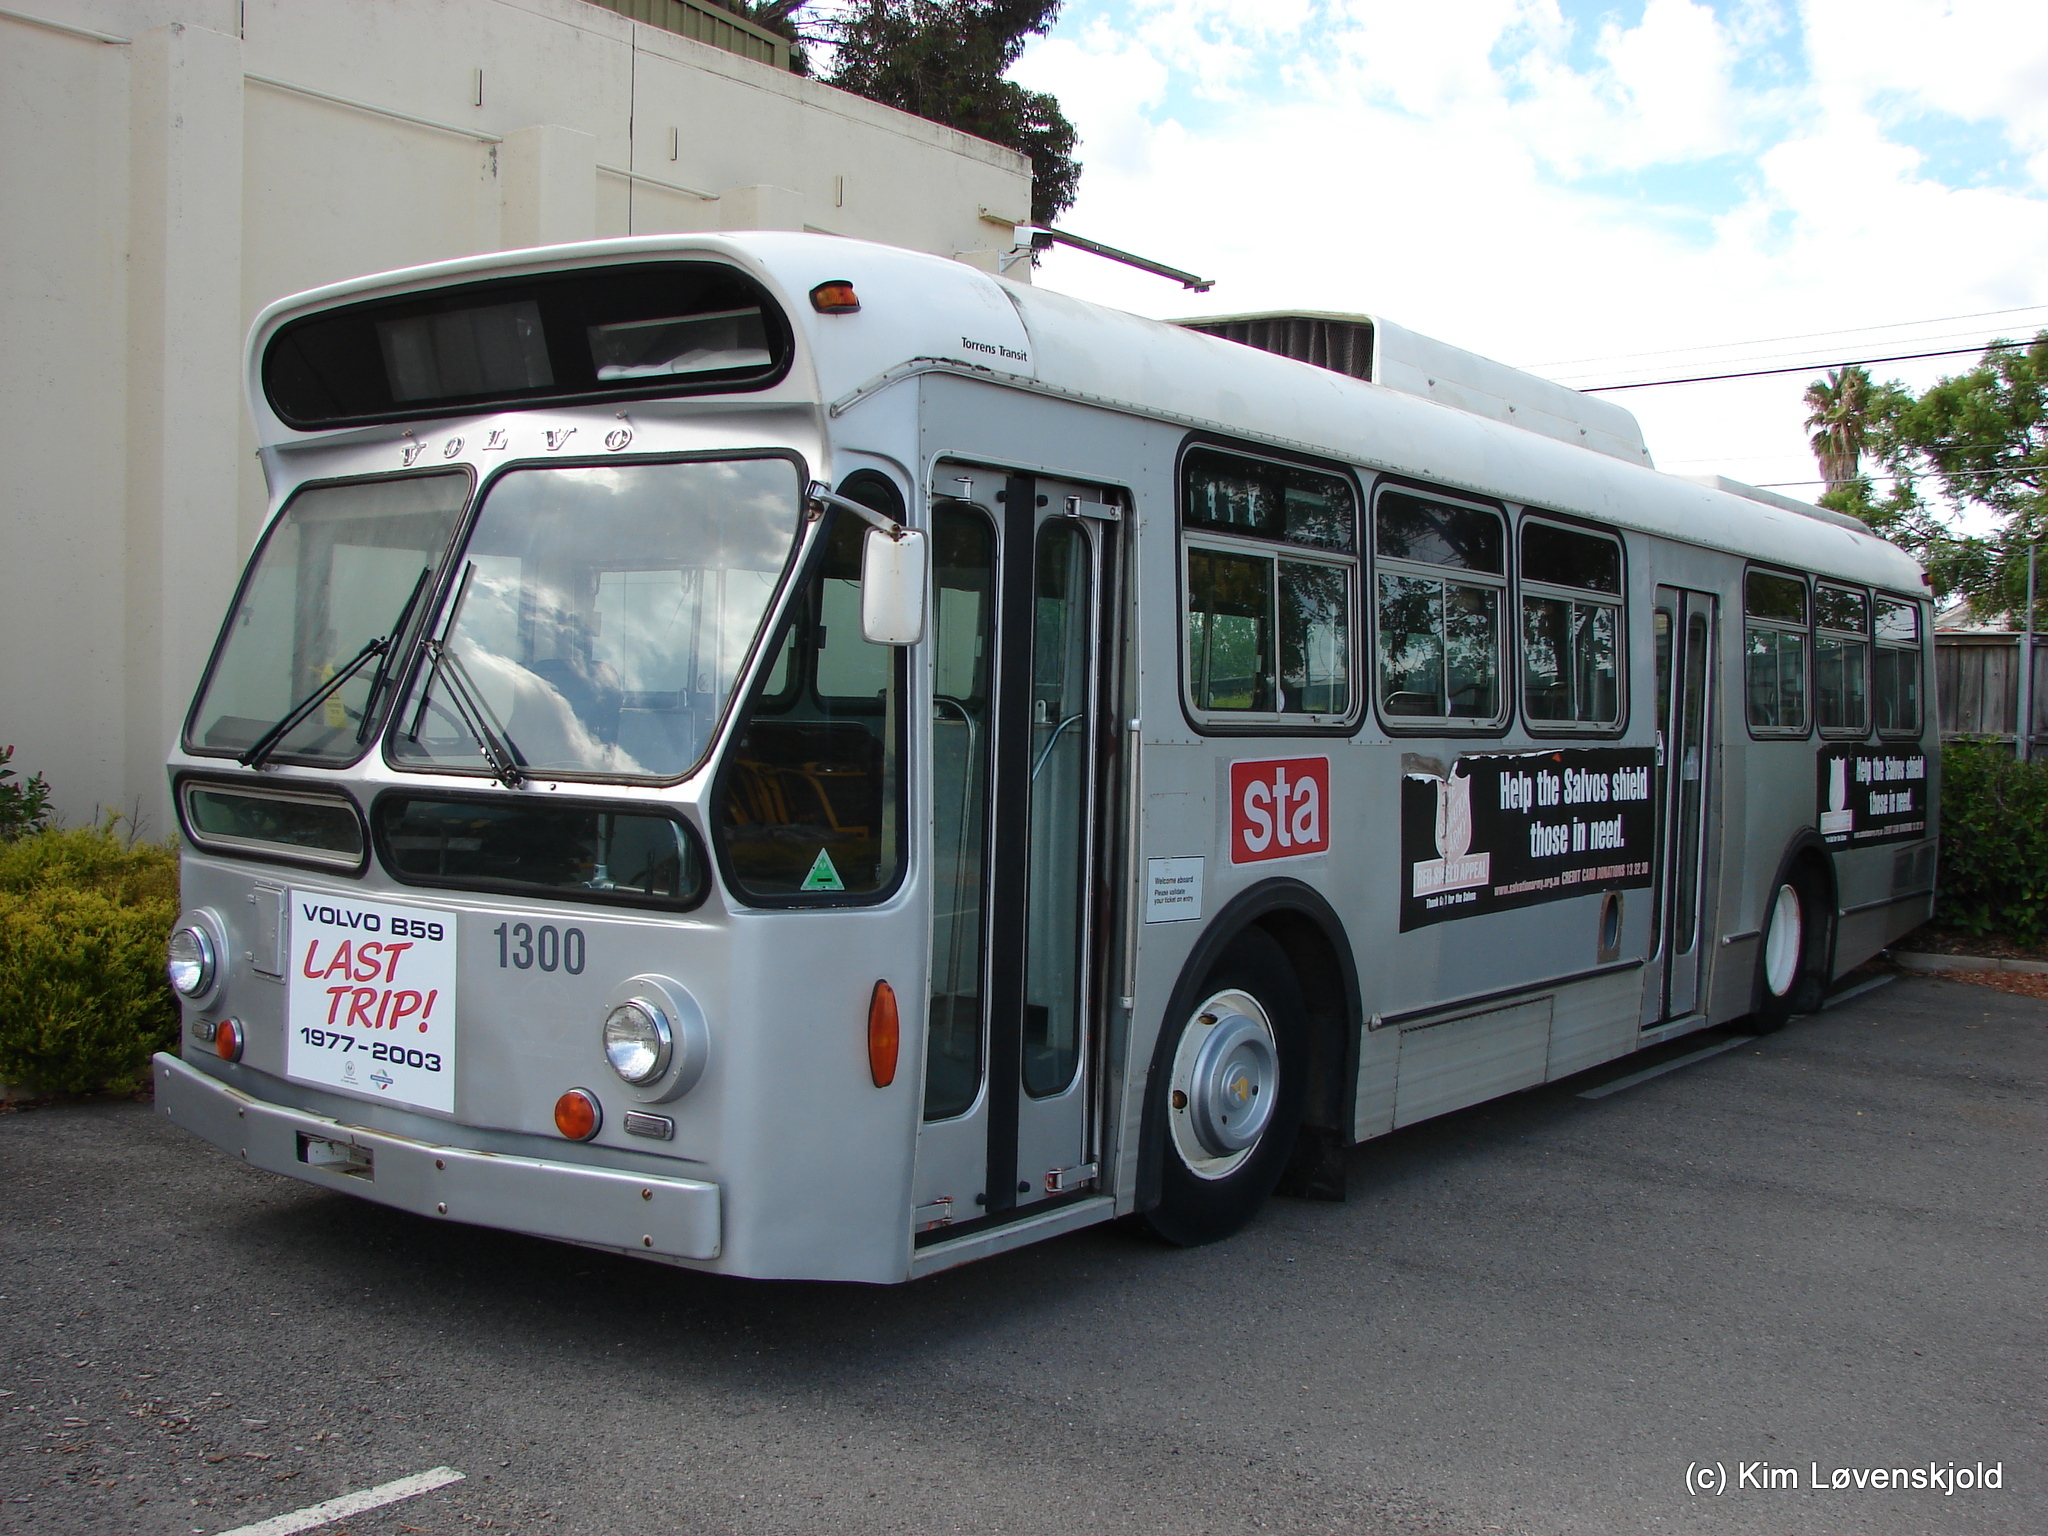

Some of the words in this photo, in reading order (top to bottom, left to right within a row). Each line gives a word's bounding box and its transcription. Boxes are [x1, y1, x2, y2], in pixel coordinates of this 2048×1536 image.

[961, 336, 996, 355] Torrens
[999, 345, 1028, 362] Transit
[400, 425, 634, 466] VOLVO
[1243, 766, 1321, 853] sta
[1500, 770, 1533, 814] Help
[1537, 769, 1560, 806] the
[1563, 767, 1608, 805] Salvos
[1612, 766, 1648, 801] shield
[1530, 820, 1568, 858] those
[1572, 816, 1586, 852] in
[1590, 813, 1625, 850] need.
[1155, 876, 1177, 885] Welcome
[1417, 868, 1432, 889] RED
[1434, 863, 1459, 886] SHELD
[1460, 860, 1487, 882] APPEAL
[1561, 869, 1582, 886] CREDIT
[1581, 866, 1597, 882] CARD
[303, 903, 381, 932] VOLVO
[391, 917, 444, 942] B59
[303, 939, 414, 983] LAST
[493, 922, 586, 975] 1300
[326, 985, 438, 1034] TRIP!
[300, 1027, 442, 1072] 1977-2003
